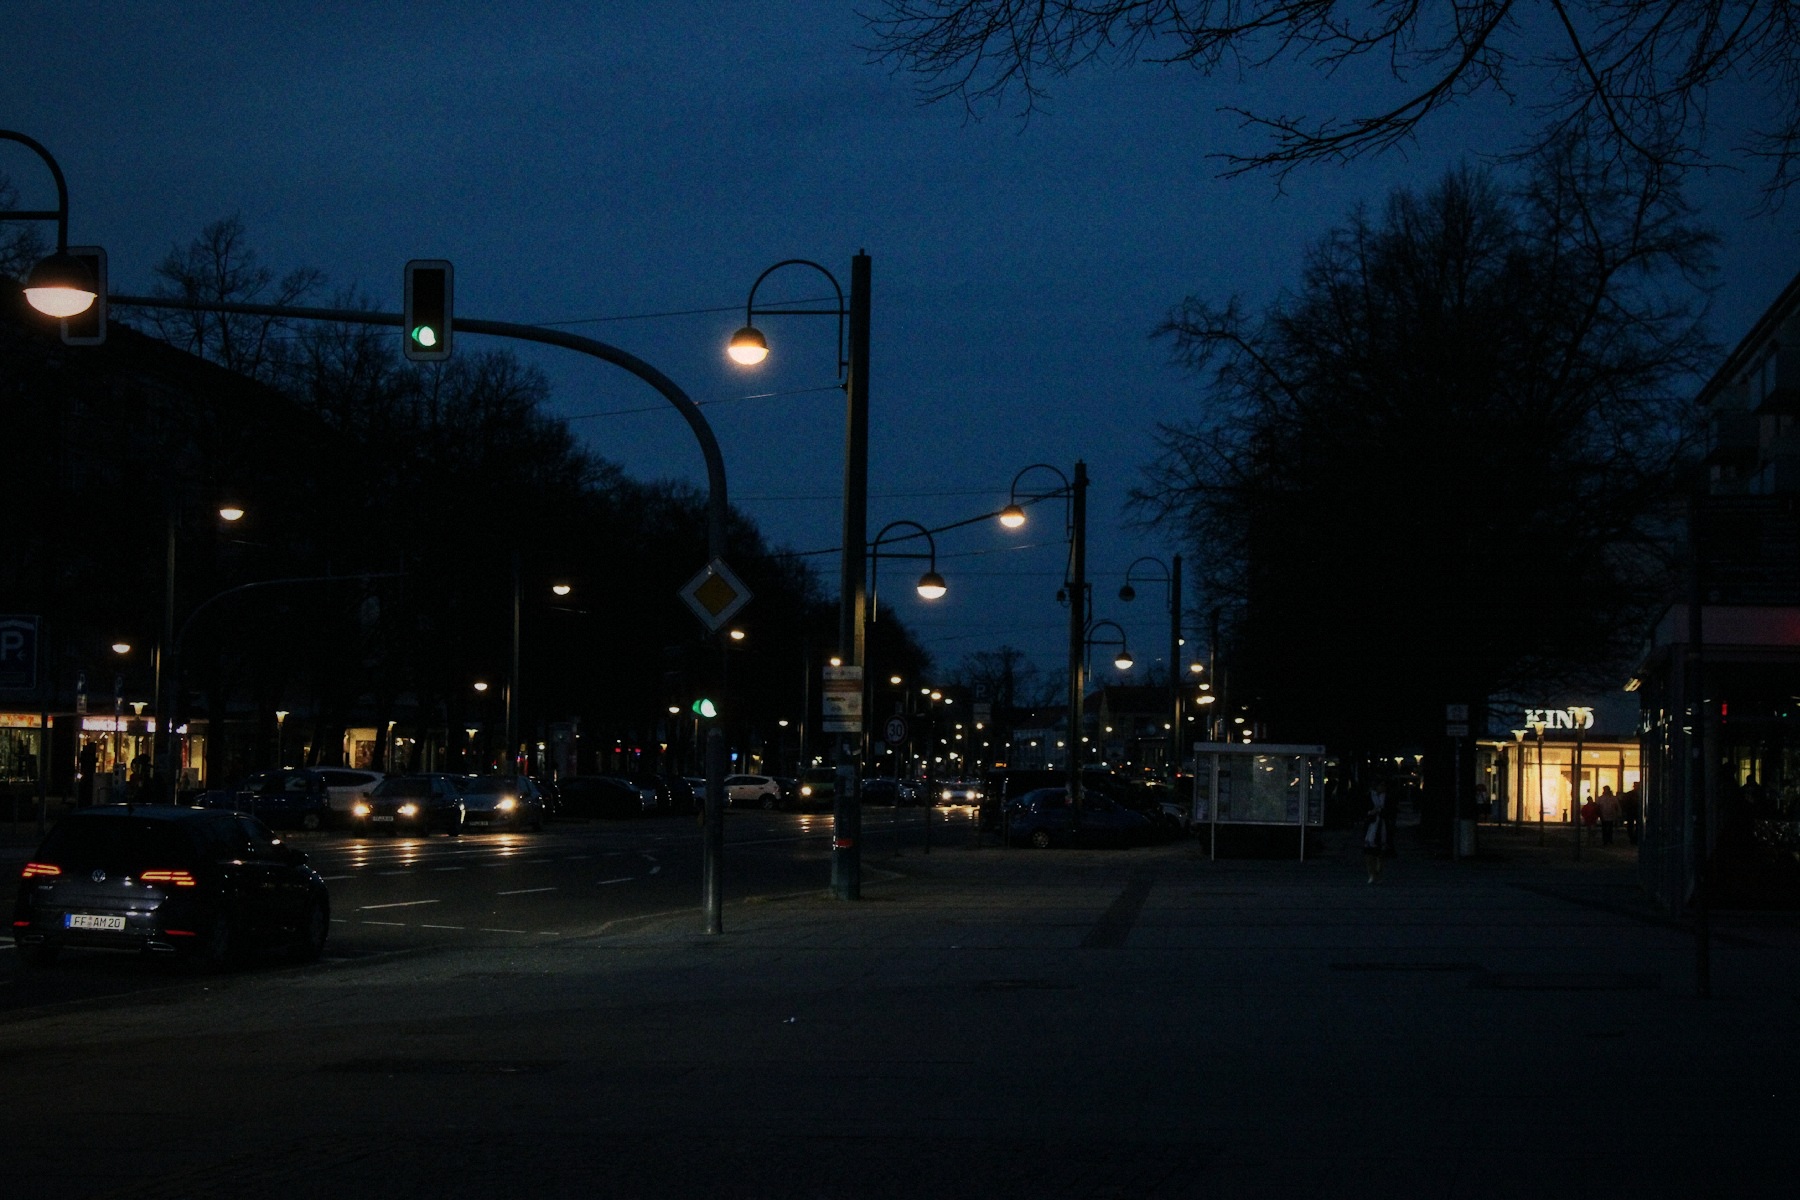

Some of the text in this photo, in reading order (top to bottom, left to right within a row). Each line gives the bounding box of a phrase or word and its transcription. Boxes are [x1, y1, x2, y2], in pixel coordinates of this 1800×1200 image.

[1, 630, 24, 661] P
[888, 722, 903, 737] 30
[74, 916, 121, 928] FF AM 20
